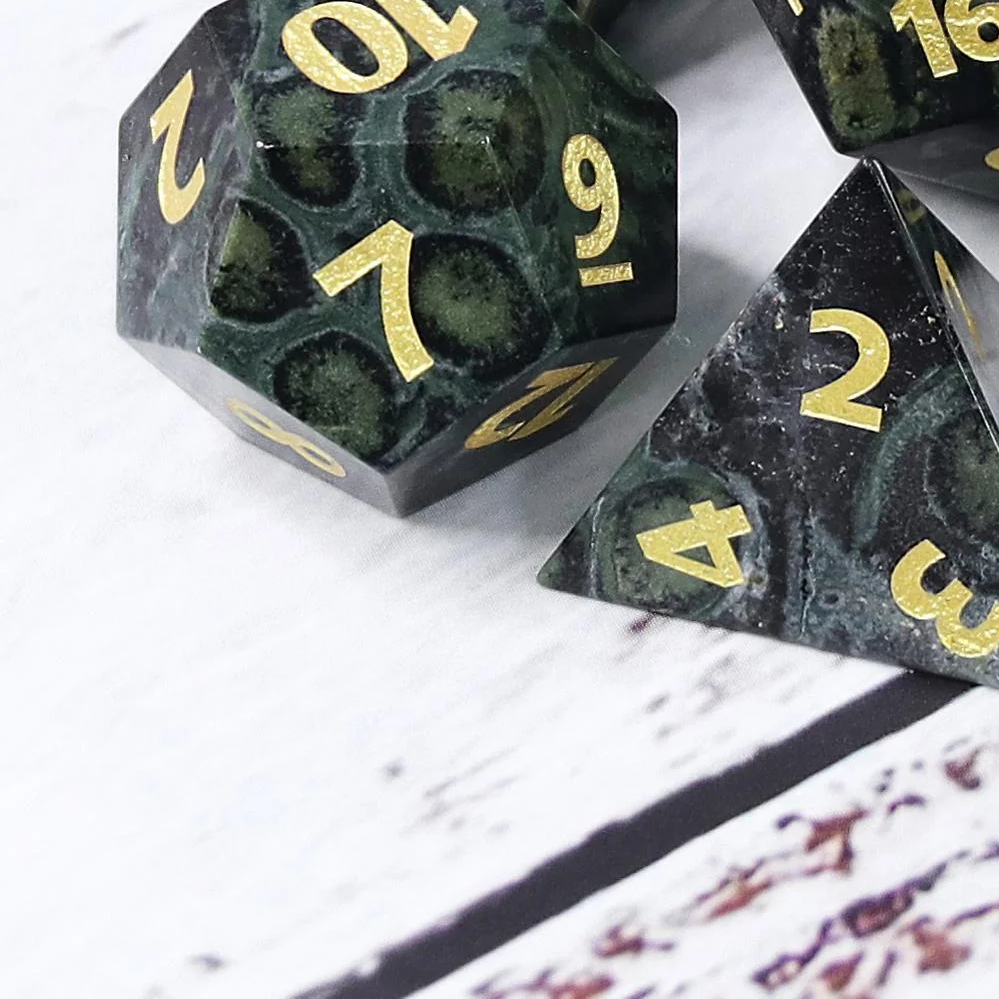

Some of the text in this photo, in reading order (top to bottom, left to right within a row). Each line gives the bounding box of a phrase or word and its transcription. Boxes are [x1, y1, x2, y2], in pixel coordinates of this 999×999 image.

[150, 70, 206, 225] 2
[311, 218, 435, 383] 7
[799, 308, 892, 433] 2
[225, 397, 347, 478] 8
[635, 499, 754, 588] 4
